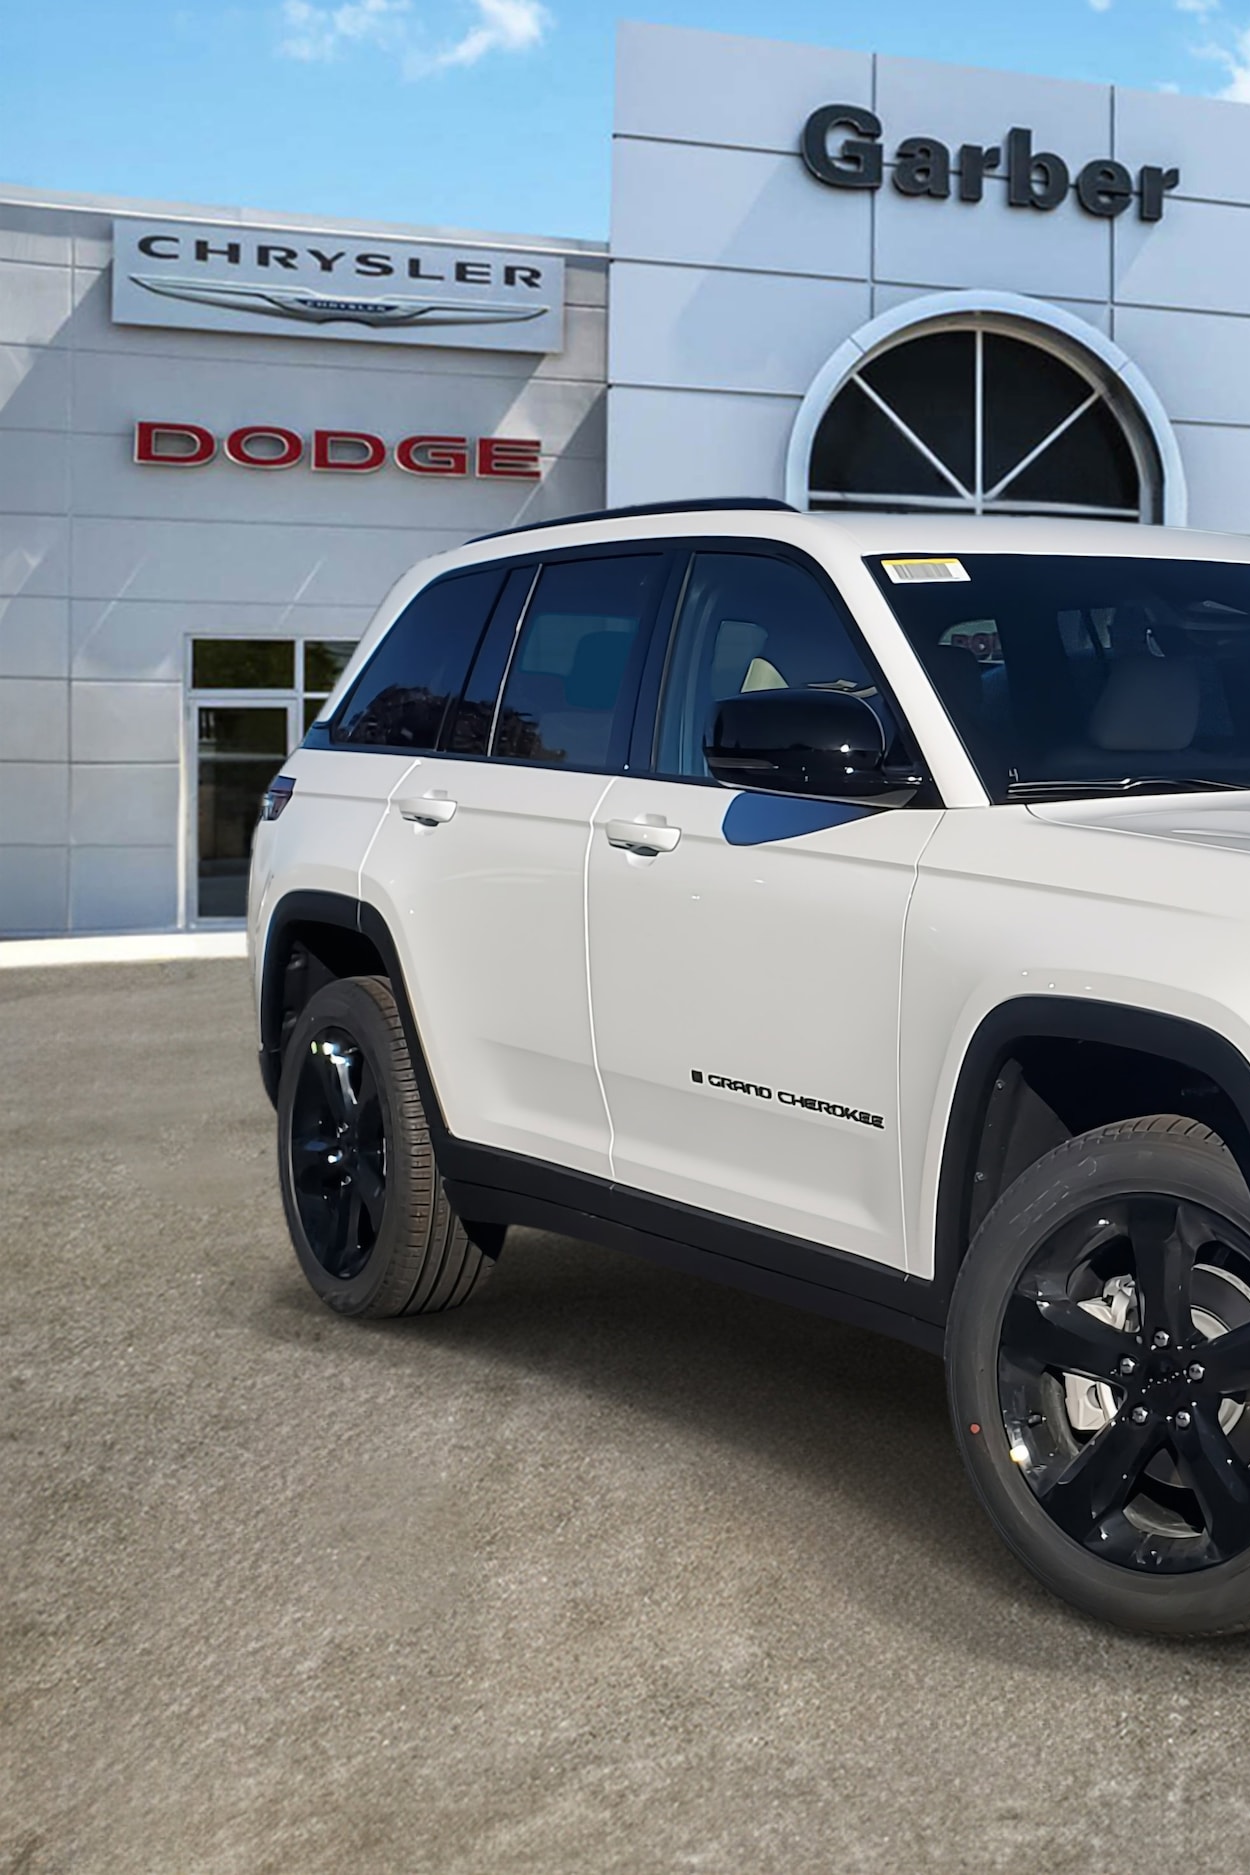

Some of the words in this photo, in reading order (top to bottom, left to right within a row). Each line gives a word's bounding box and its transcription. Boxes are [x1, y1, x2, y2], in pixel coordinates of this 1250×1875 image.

[800, 103, 1180, 222] Garber
[138, 235, 543, 288] CHRYSLER
[134, 420, 541, 480] DODGE
[707, 1074, 773, 1100] GRAND
[777, 1091, 885, 1130] CHEROKEE
